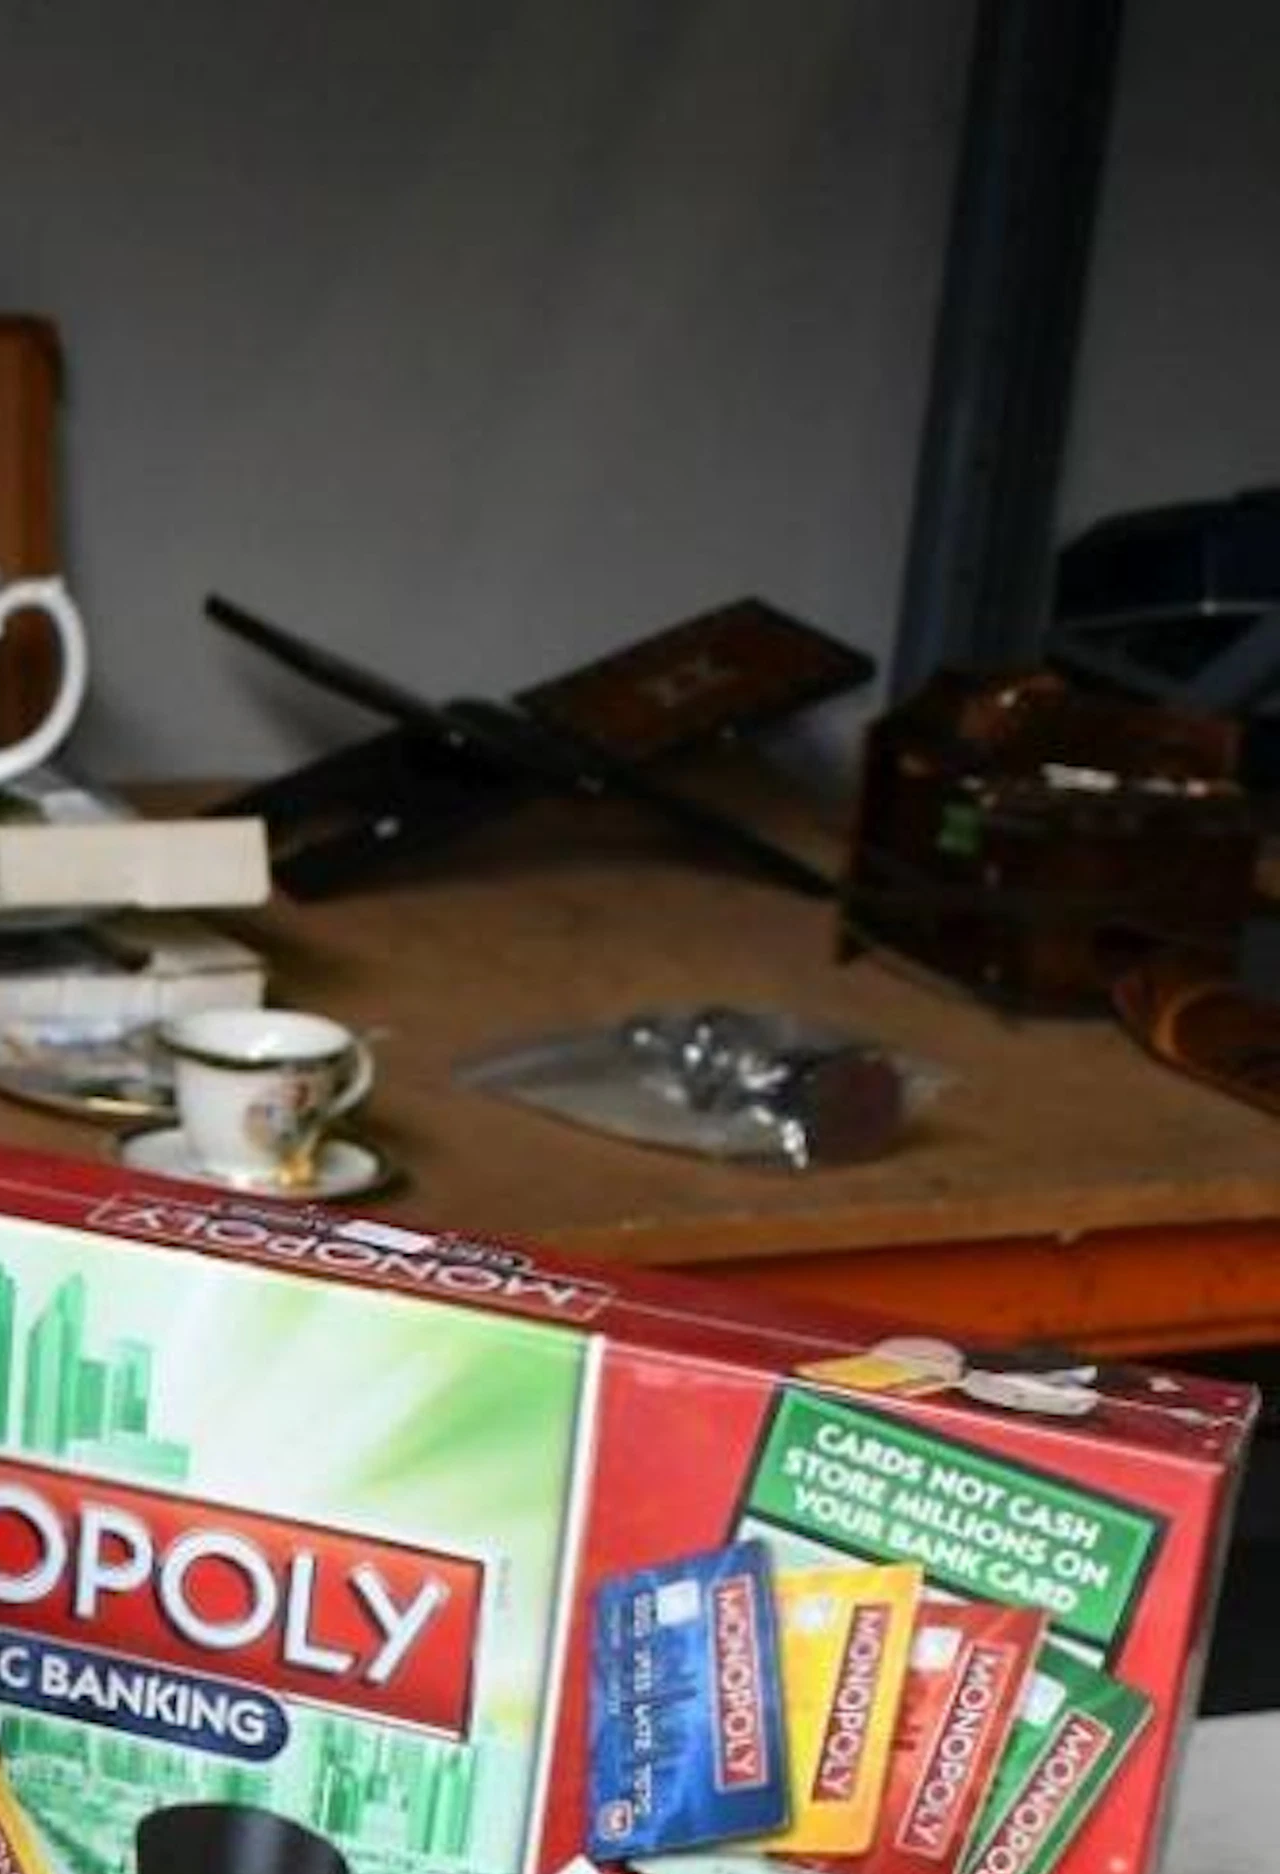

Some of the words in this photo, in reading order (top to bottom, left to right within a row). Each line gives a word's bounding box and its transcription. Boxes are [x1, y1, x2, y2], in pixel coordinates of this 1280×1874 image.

[117, 1204, 579, 1308] MONOPOLY
[783, 1447, 891, 1505] STORE
[890, 1486, 1049, 1568] MILLIONS
[1051, 1545, 1112, 1590] ON
[791, 1485, 883, 1542] YOUR
[886, 1524, 984, 1581] BANK
[985, 1558, 1080, 1614] CARD
[816, 1423, 925, 1481] CARDS
[927, 1466, 1006, 1510] NOT
[1007, 1496, 1102, 1550] CASH
[41, 1655, 268, 1746] BANKING
[716, 1578, 759, 1779] MONOPOLY
[910, 1647, 1004, 1849] MONOPOLY
